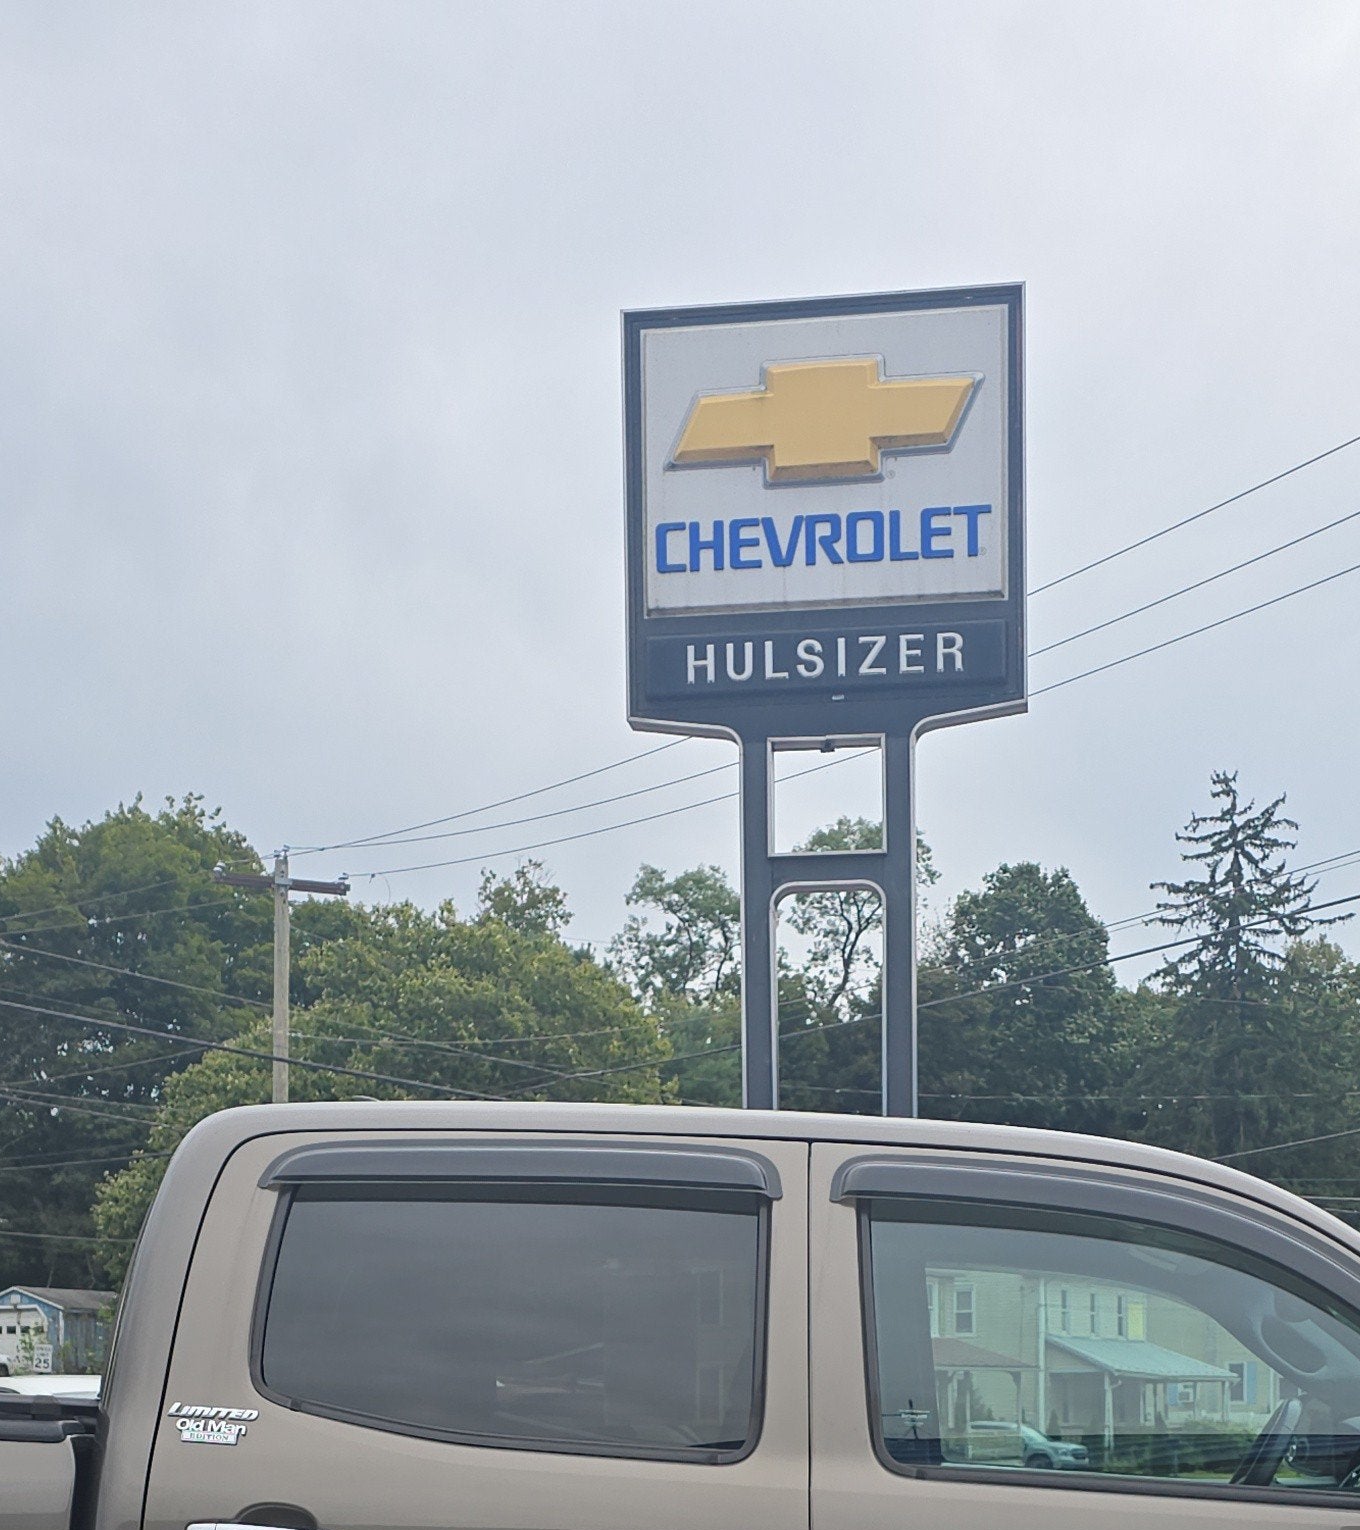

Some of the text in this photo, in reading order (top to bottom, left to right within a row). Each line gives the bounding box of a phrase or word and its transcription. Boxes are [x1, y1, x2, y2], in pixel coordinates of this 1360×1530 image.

[655, 504, 992, 574] CHEVROLET
[686, 632, 965, 685] HULSIZER
[34, 1357, 50, 1370] 25
[167, 1402, 259, 1421] LIMITED
[176, 1418, 247, 1435] Old Man
[189, 1432, 229, 1441] EDITION
